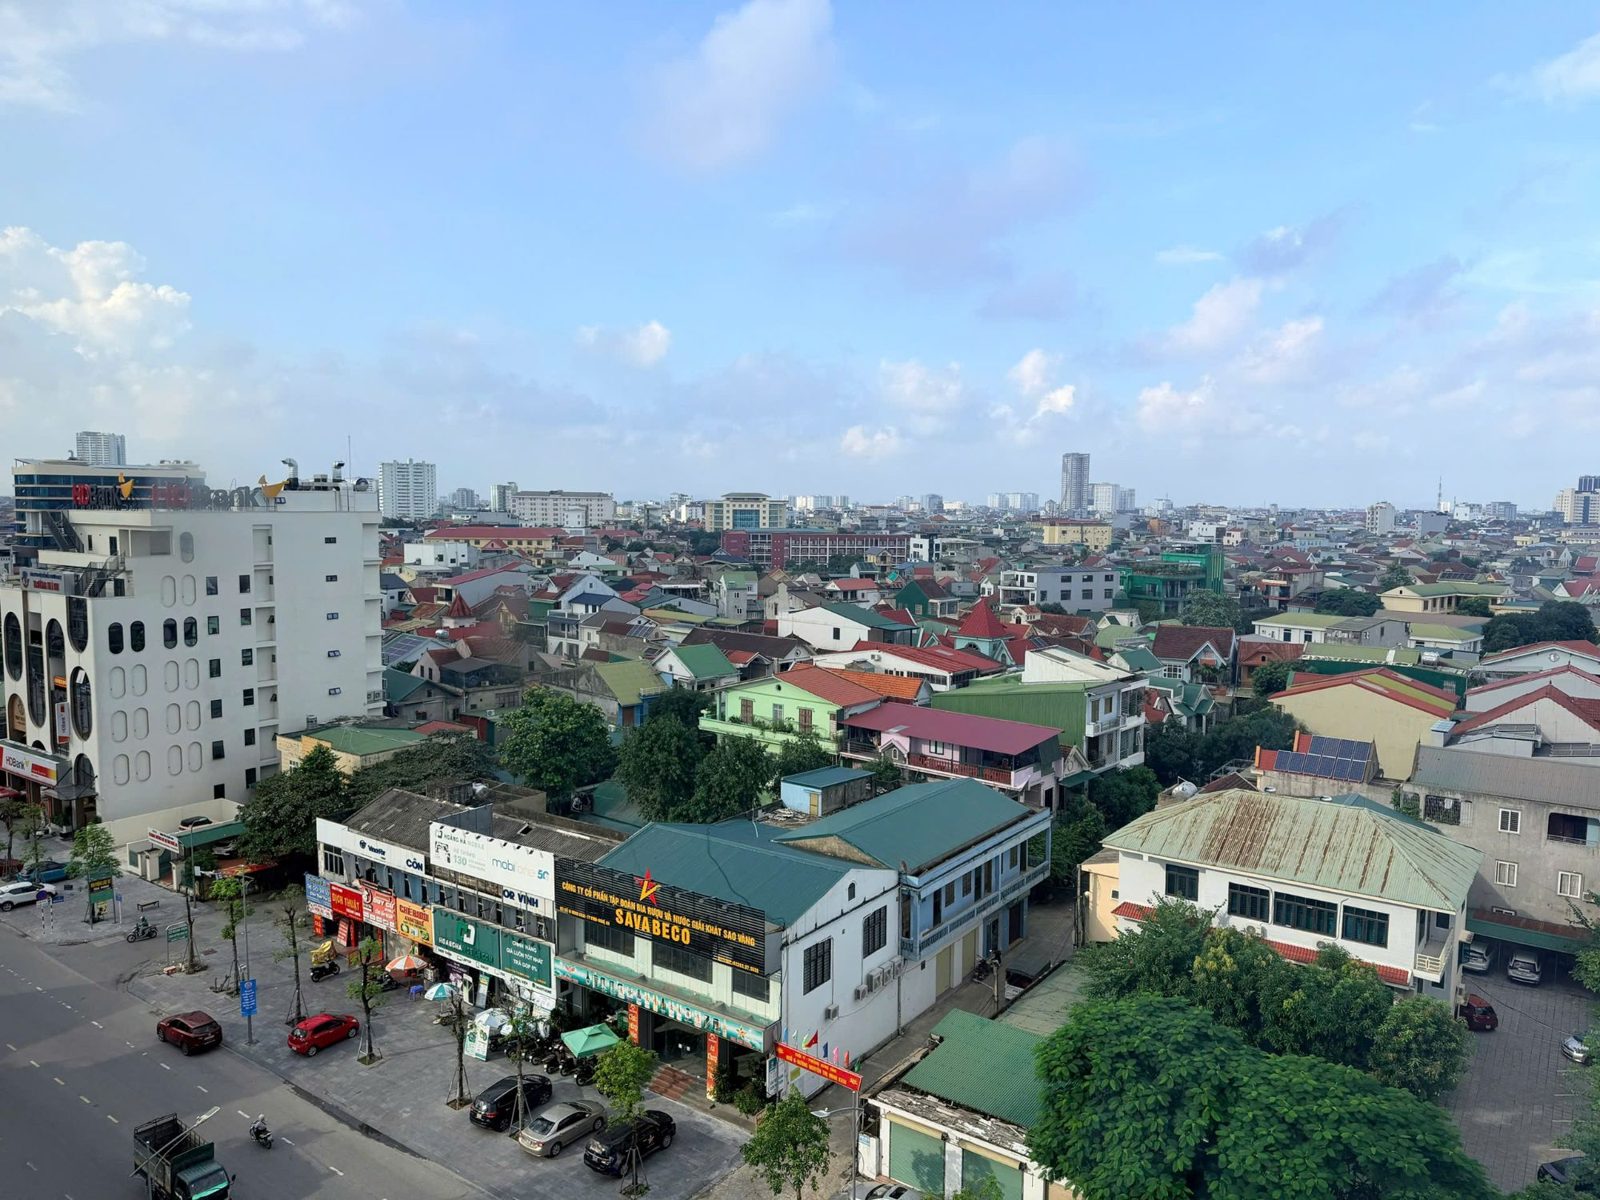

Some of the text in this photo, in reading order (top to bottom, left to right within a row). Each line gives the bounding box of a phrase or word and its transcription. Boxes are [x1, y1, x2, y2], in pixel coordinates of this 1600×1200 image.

[6, 755, 26, 771] HDBank
[406, 857, 424, 872] CÔN
[332, 893, 344, 906] DỊCH
[518, 892, 539, 908] VINH
[562, 881, 756, 947] CÔNG TY CỔ PHẦN TẬP ĐOÀN BIA RƯỢU VÀ NƯỚC GIẢI KHÁT SAO VÀNG
[615, 908, 691, 945] SAVABECO
